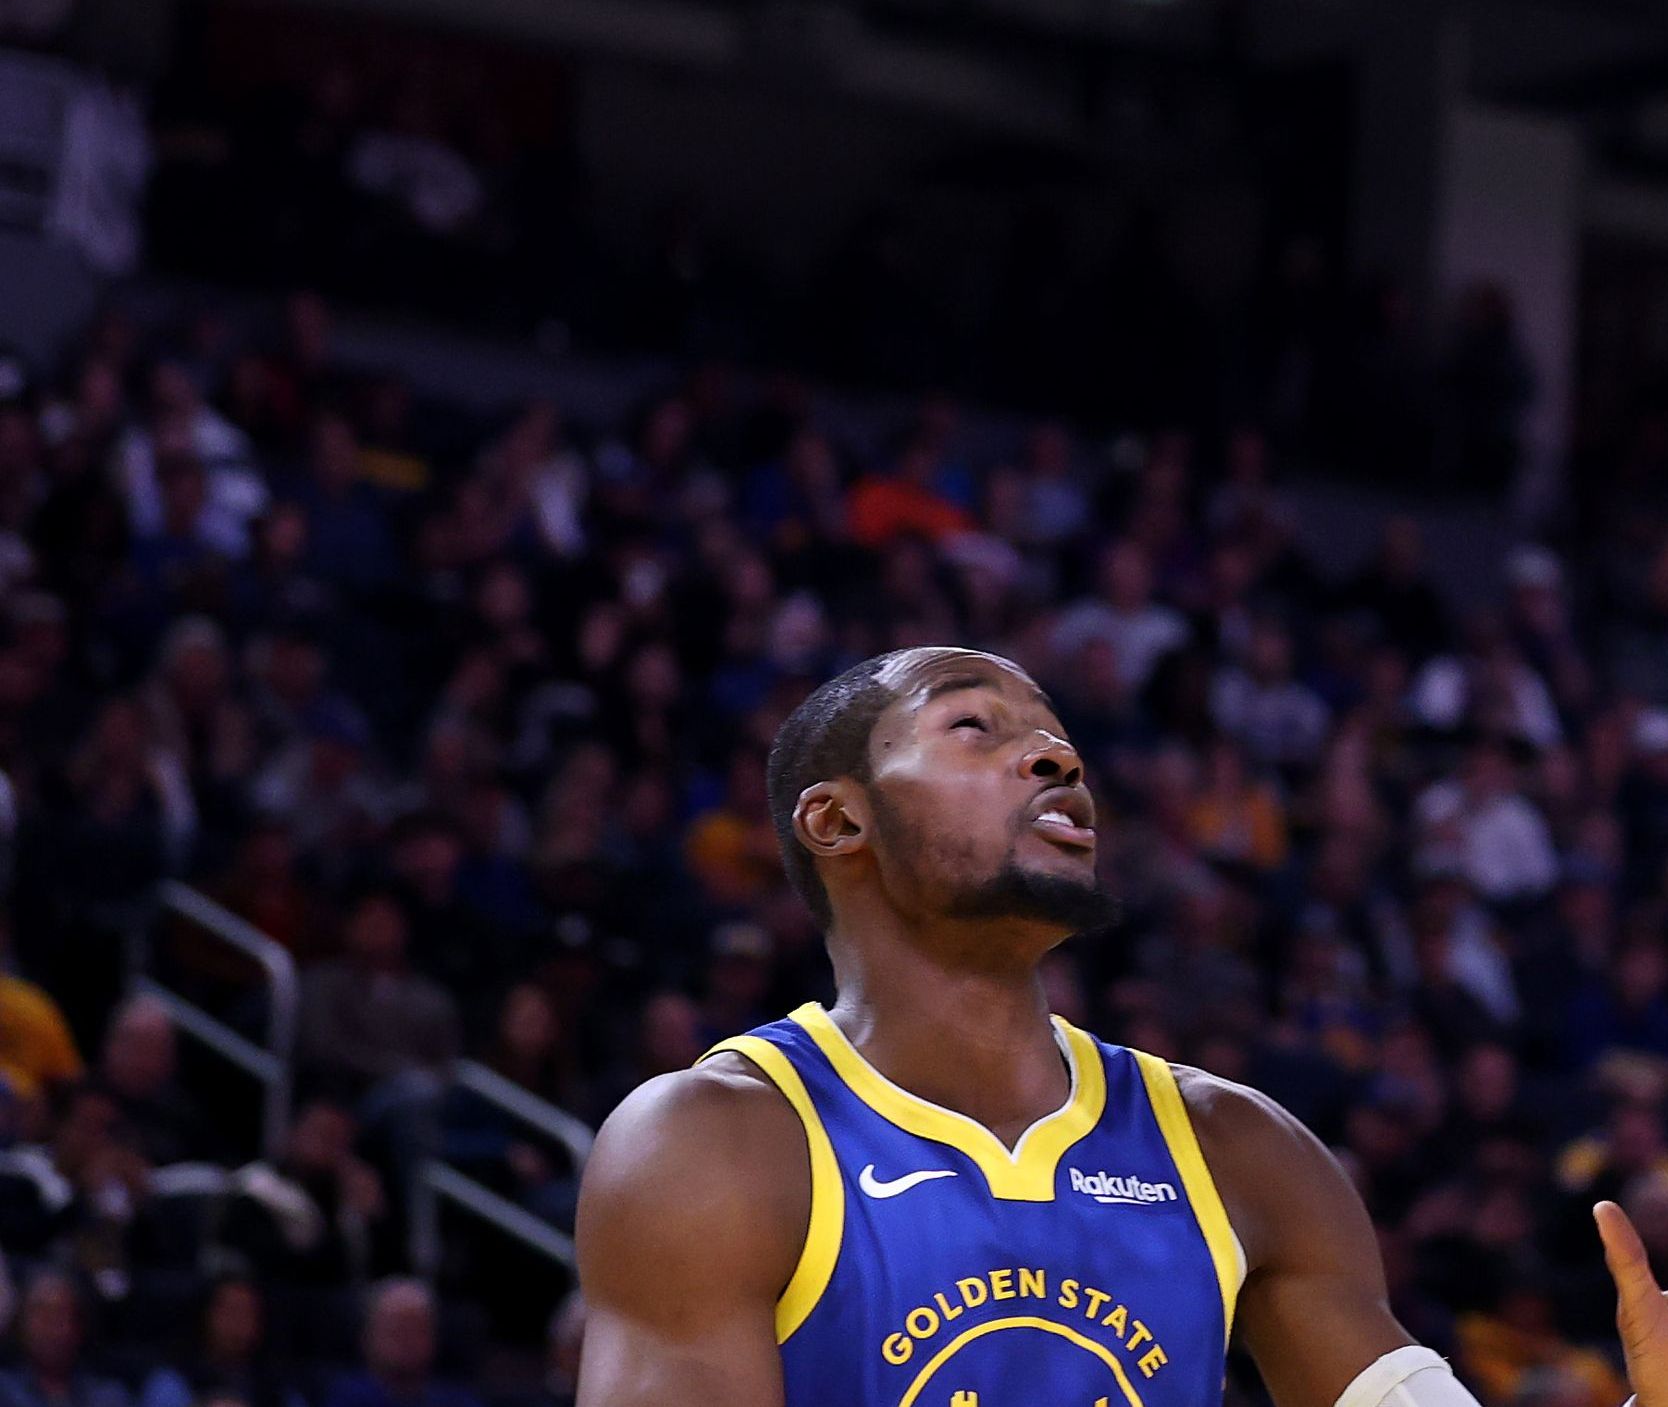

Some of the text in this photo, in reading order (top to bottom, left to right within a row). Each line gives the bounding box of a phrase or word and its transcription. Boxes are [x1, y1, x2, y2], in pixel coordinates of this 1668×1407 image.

[1068, 1167, 1177, 1203] Rakuten
[881, 1267, 1169, 1379] GOLDEN STATE
